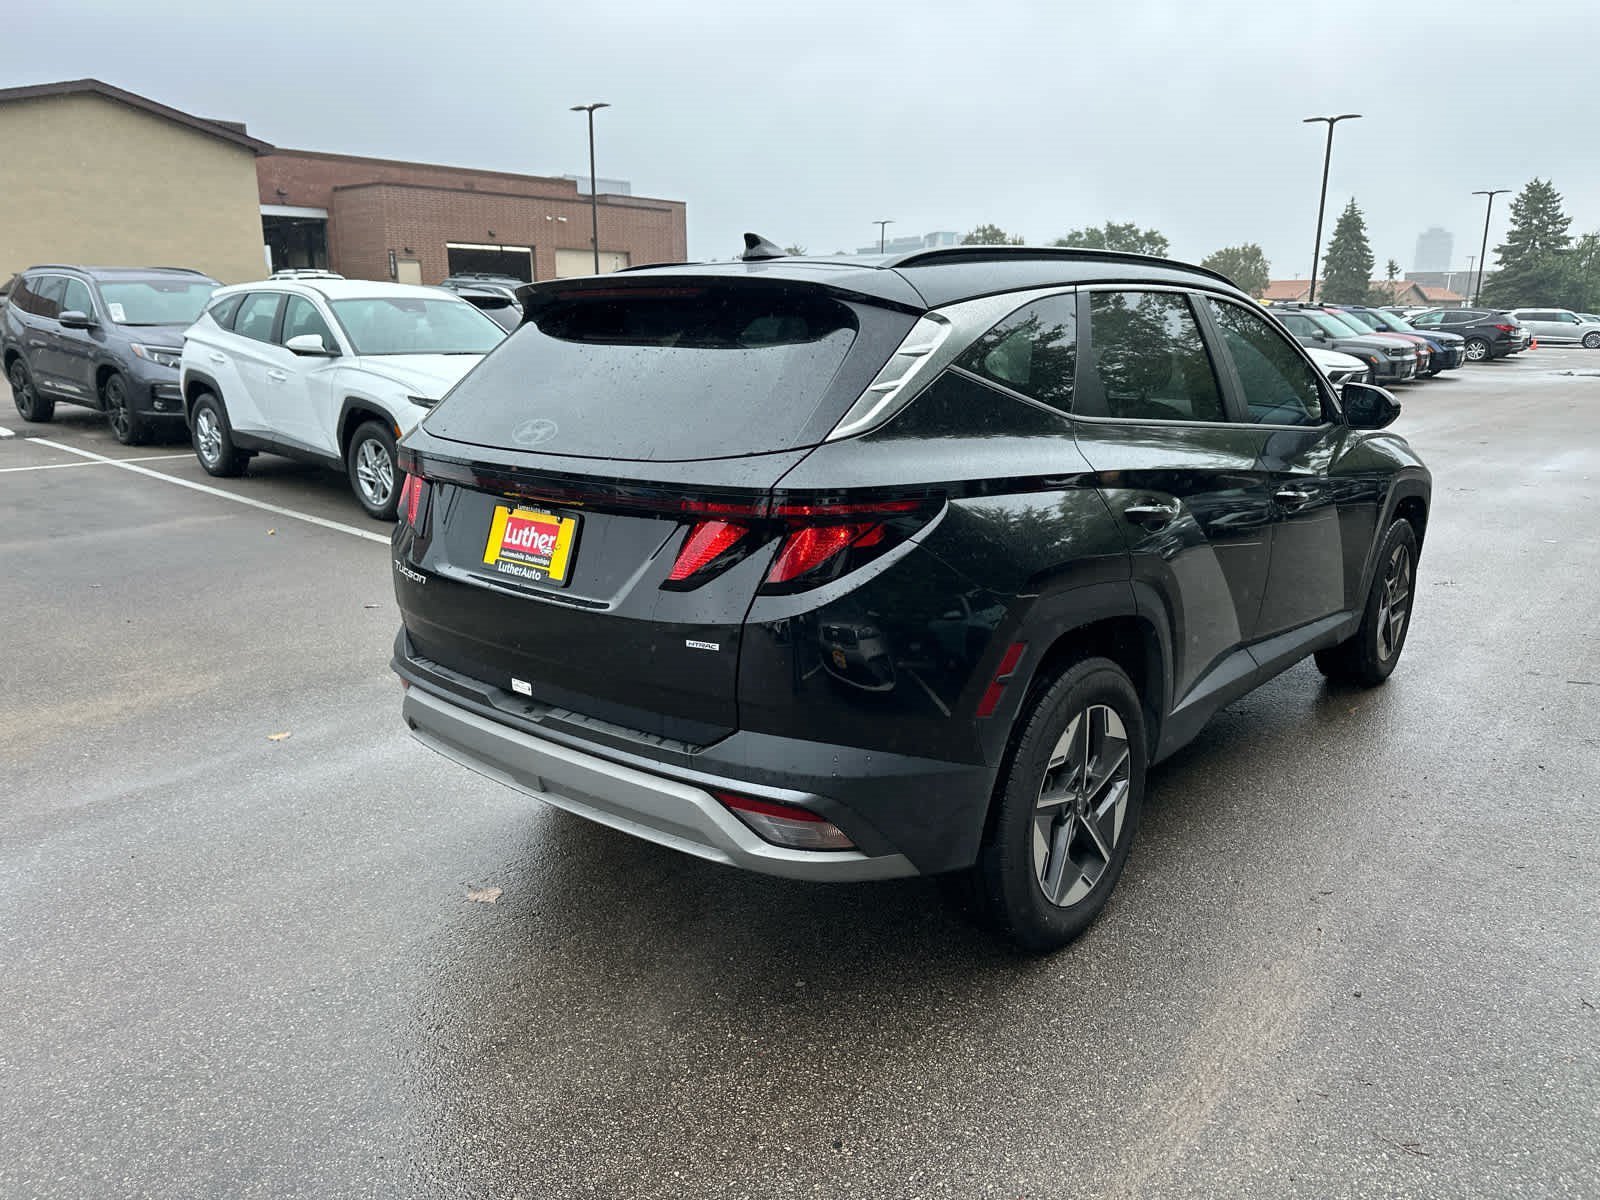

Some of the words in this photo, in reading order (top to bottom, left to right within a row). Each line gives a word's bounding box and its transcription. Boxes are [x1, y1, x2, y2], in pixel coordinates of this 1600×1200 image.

[503, 521, 556, 549] Luther
[500, 550, 525, 561] Automobile
[525, 554, 550, 566] Dealerships
[498, 561, 541, 581] LutherAuto
[687, 641, 718, 650] HTRAC
